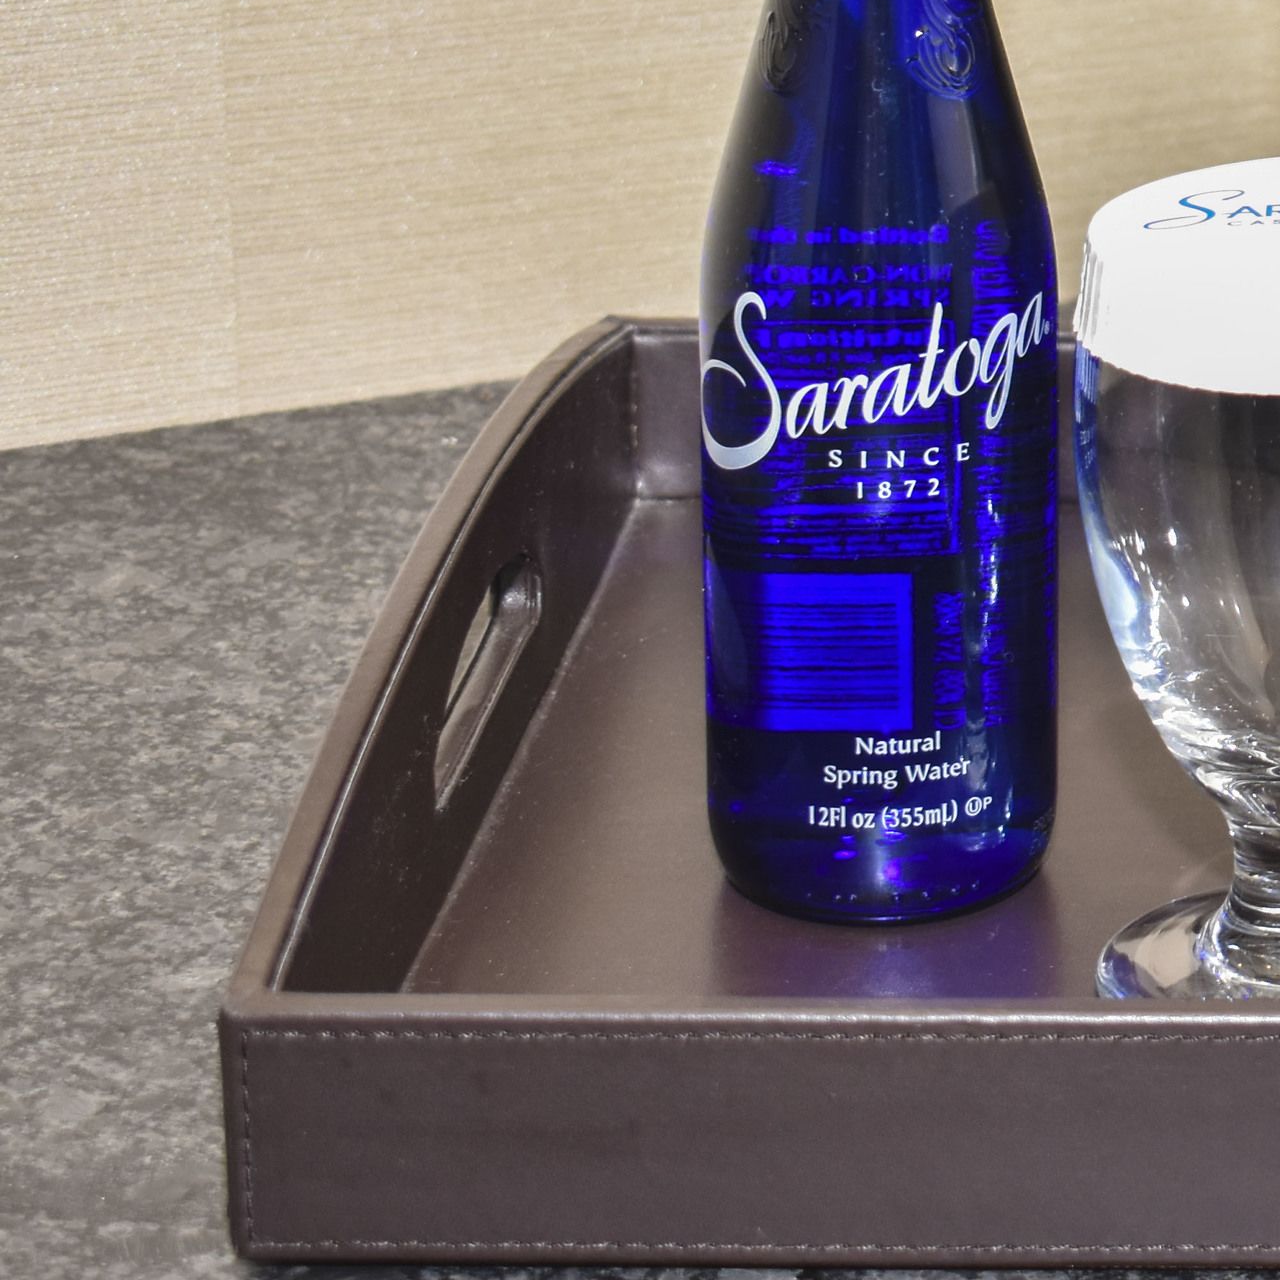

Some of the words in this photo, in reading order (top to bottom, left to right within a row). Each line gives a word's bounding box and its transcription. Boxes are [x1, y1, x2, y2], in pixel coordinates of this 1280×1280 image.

[828, 442, 971, 469] SINCE
[856, 478, 941, 499] 1872
[855, 731, 941, 756] Natural
[823, 764, 898, 790] Spring
[904, 757, 971, 784] Water
[852, 813, 876, 829] oz
[881, 802, 958, 830] (355mL)
